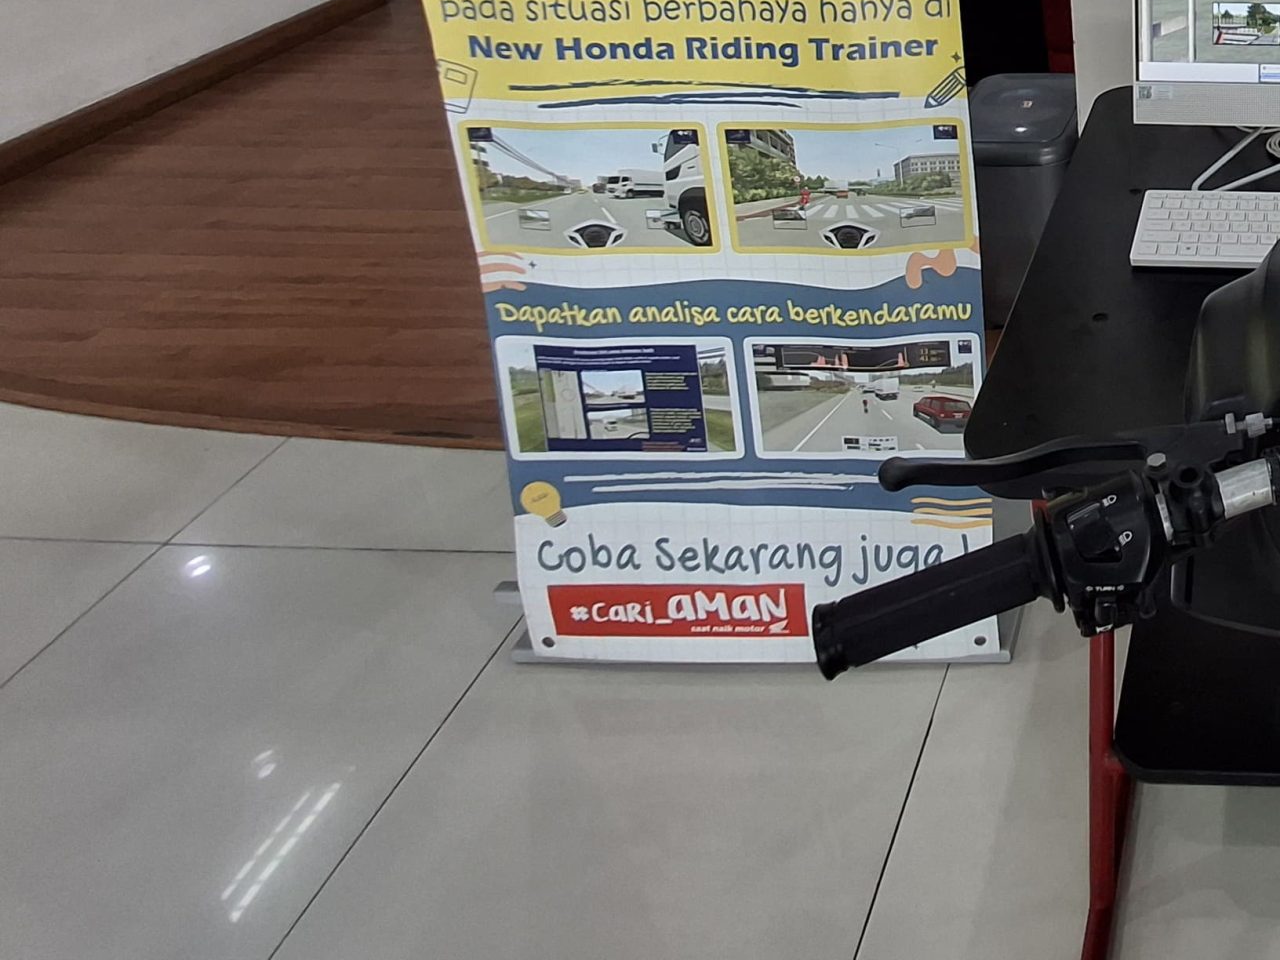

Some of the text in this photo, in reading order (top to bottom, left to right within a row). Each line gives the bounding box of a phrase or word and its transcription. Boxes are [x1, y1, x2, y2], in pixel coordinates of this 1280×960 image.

[468, 35, 939, 67] New Honda Riding Trainer
[495, 300, 972, 332] Dapatkan analisa cara berkendaramu
[537, 533, 641, 573] Coba
[655, 537, 843, 587] Sekarang
[852, 534, 944, 585] juga
[735, 625, 765, 633] motor
